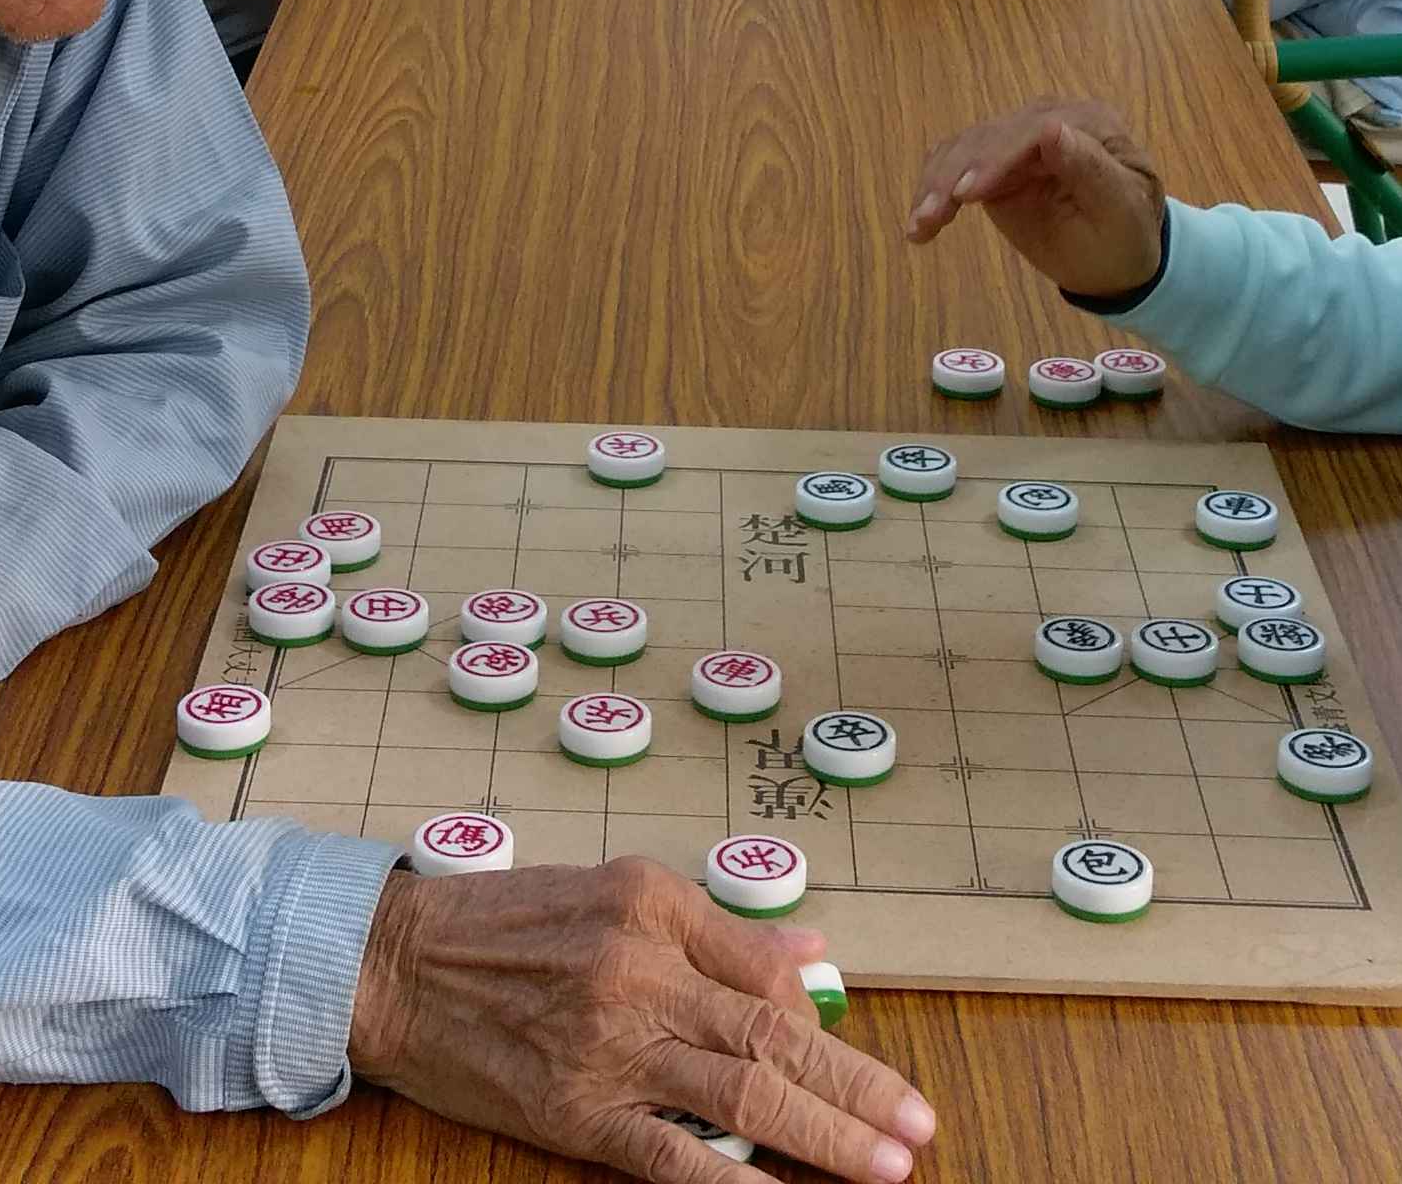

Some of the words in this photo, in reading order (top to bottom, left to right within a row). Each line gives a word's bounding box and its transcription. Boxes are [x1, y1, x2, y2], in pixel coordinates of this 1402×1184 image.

[946, 353, 986, 371] 兵
[606, 437, 648, 455] 兵
[894, 449, 942, 469] 卒
[812, 479, 856, 495] 馬
[1018, 488, 1059, 507] 包
[739, 514, 809, 584] 楚河
[1235, 583, 1282, 605] 士
[477, 595, 532, 619] 炮
[580, 604, 628, 626] 兵
[1052, 622, 1100, 647] 象
[1152, 626, 1201, 649] 士
[1260, 623, 1311, 646] 將
[467, 646, 521, 672] 炮
[711, 657, 760, 683] 俥
[194, 691, 252, 719] 相
[584, 700, 632, 725] 兵
[825, 718, 877, 747] 卒
[1302, 735, 1356, 761] 象
[436, 821, 489, 853] 傌
[727, 844, 783, 873] 兵
[1076, 849, 1129, 877] 包
